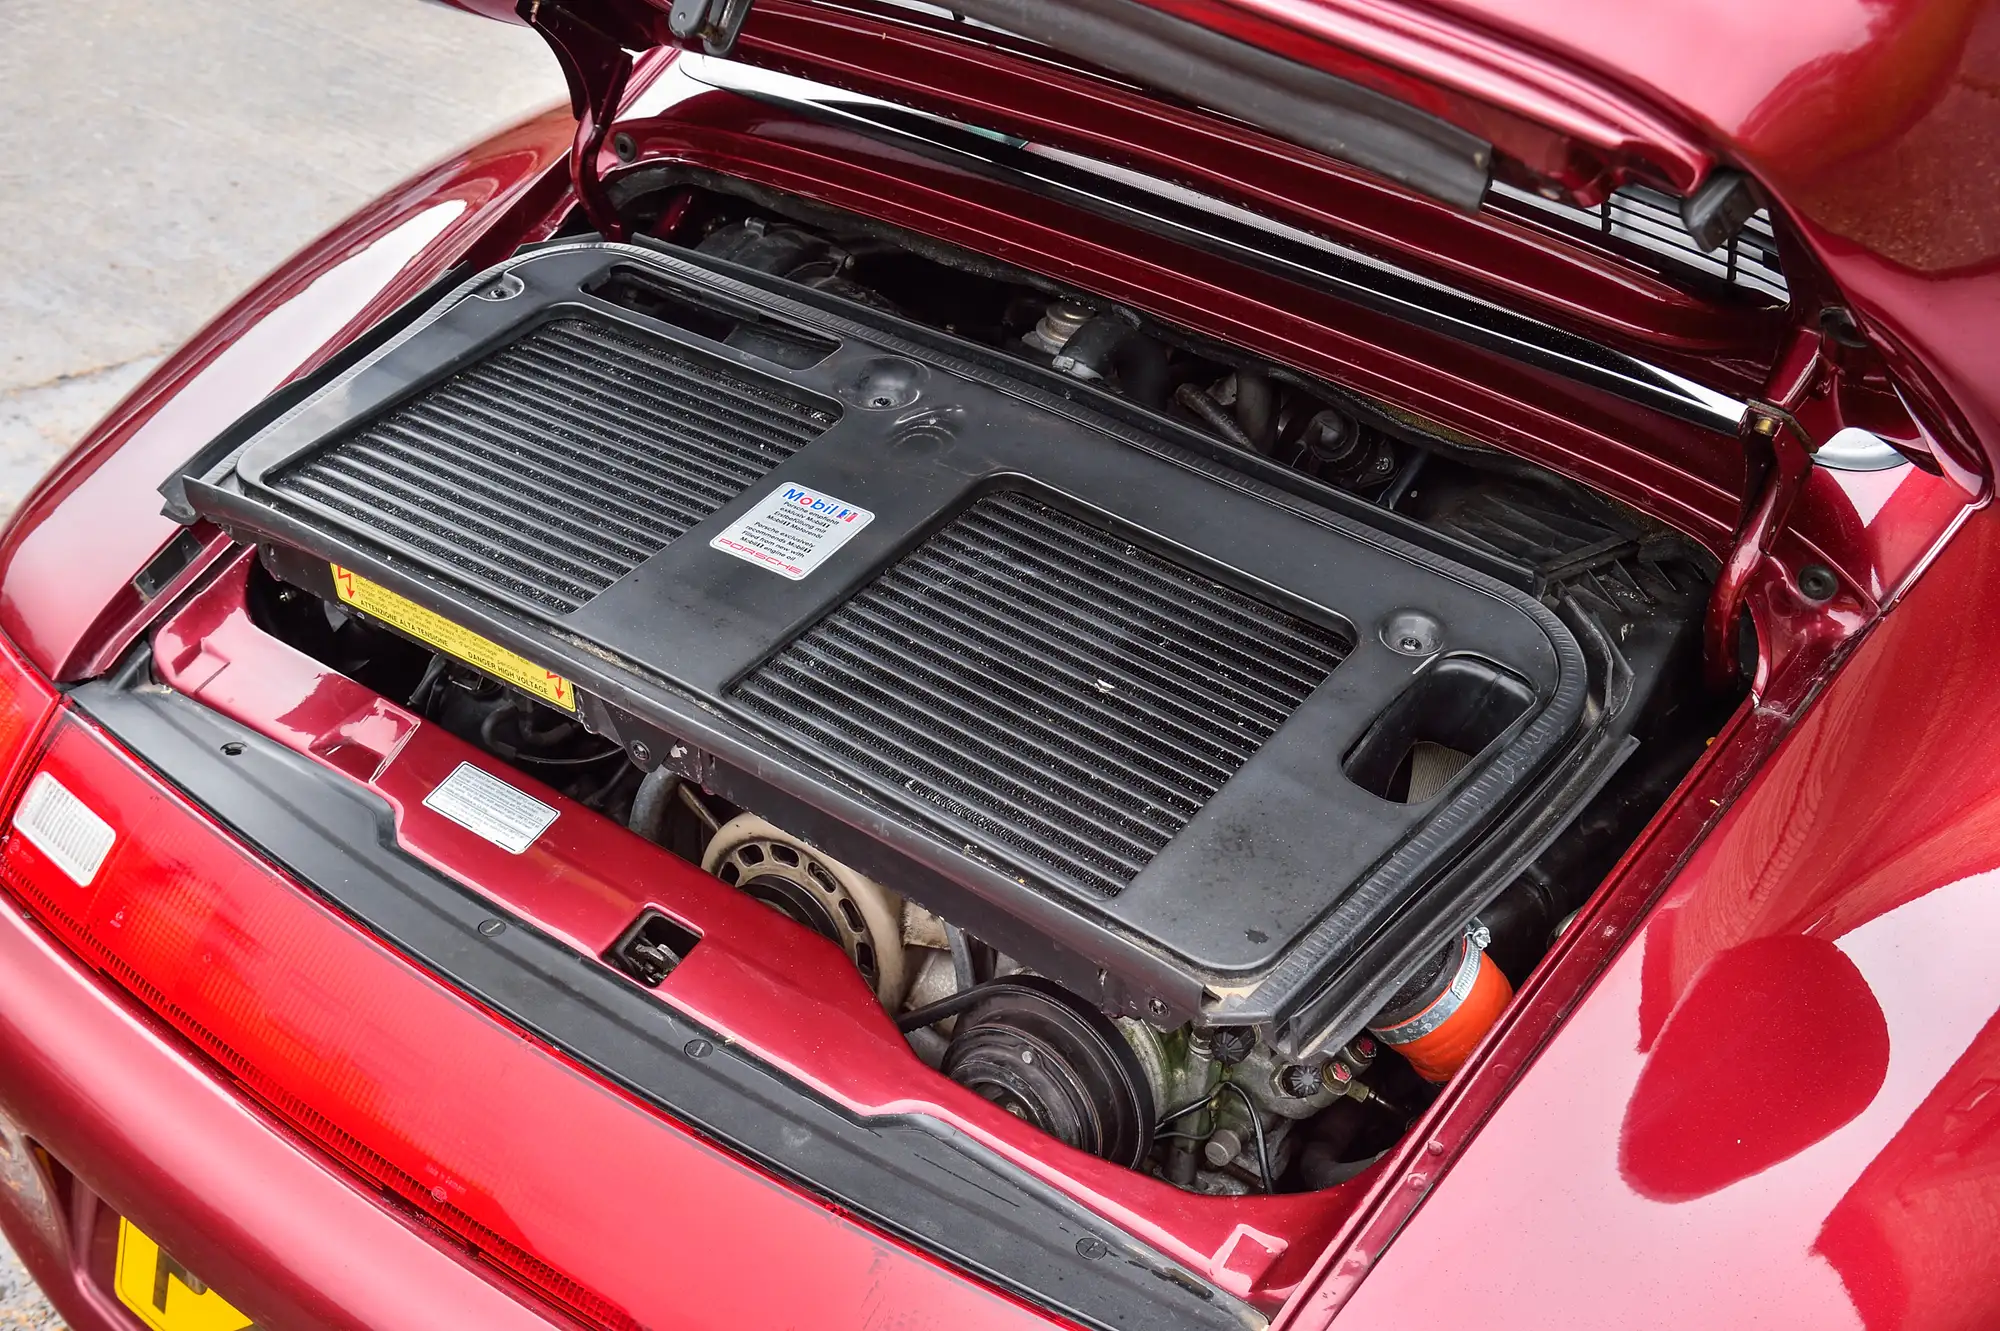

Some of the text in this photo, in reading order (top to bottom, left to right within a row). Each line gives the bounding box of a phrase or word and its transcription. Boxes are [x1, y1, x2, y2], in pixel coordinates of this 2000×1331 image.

[780, 507, 807, 520] exklusiv
[782, 488, 839, 515] Mobil
[784, 501, 839, 526] Porsche empfiehlt
[746, 525, 786, 543] recommends
[754, 522, 816, 548] Porsche exclusively
[774, 511, 827, 534] Erstbefüllung mit
[790, 523, 823, 539] Motorenöl
[719, 538, 802, 574] PORSCHE
[742, 530, 805, 558] Filled from new with
[763, 546, 786, 558] engine
[360, 599, 449, 648] ATTENZIONE ALTA TENSIONE
[467, 651, 549, 694] DANGER HIGH VOLTAGE
